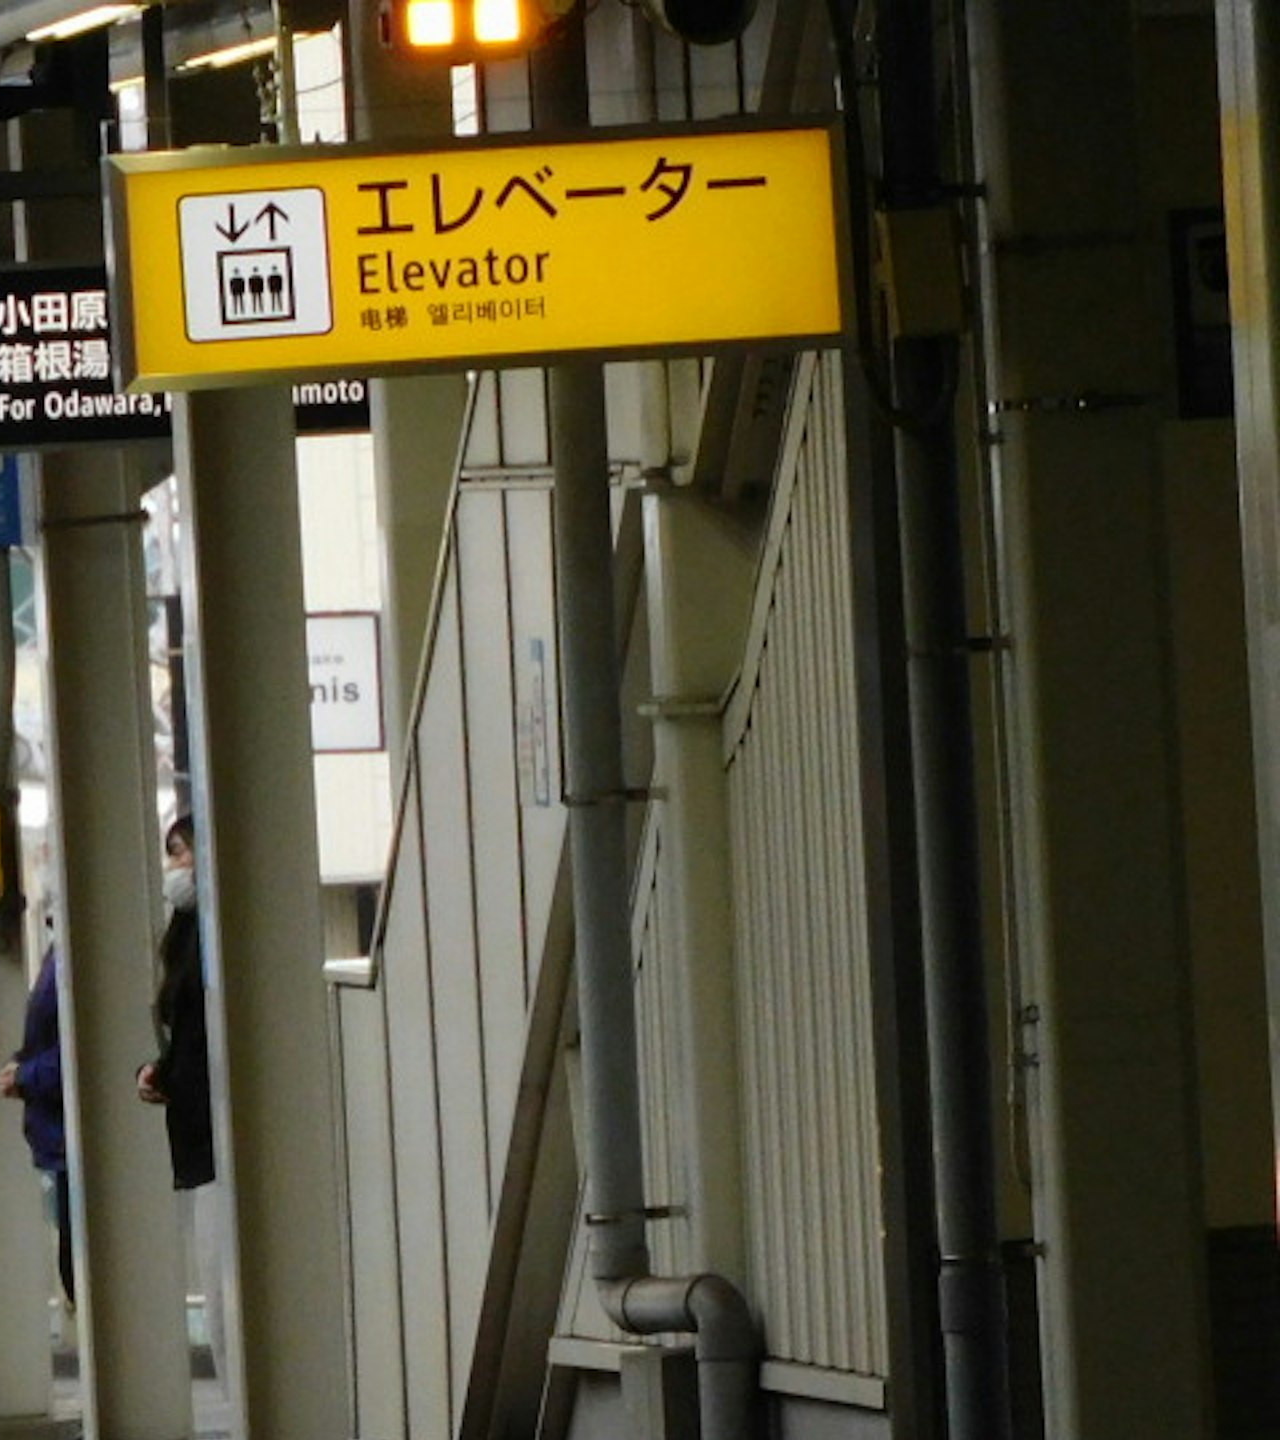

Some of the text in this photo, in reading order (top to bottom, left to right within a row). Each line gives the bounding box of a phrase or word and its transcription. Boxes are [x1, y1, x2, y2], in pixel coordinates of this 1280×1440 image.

[356, 156, 768, 235] エレベーター
[357, 248, 551, 295] Elevator
[360, 295, 547, 332] 电梯 엘리베이터
[43, 388, 163, 421] Odawara,
[292, 379, 365, 405] moto
